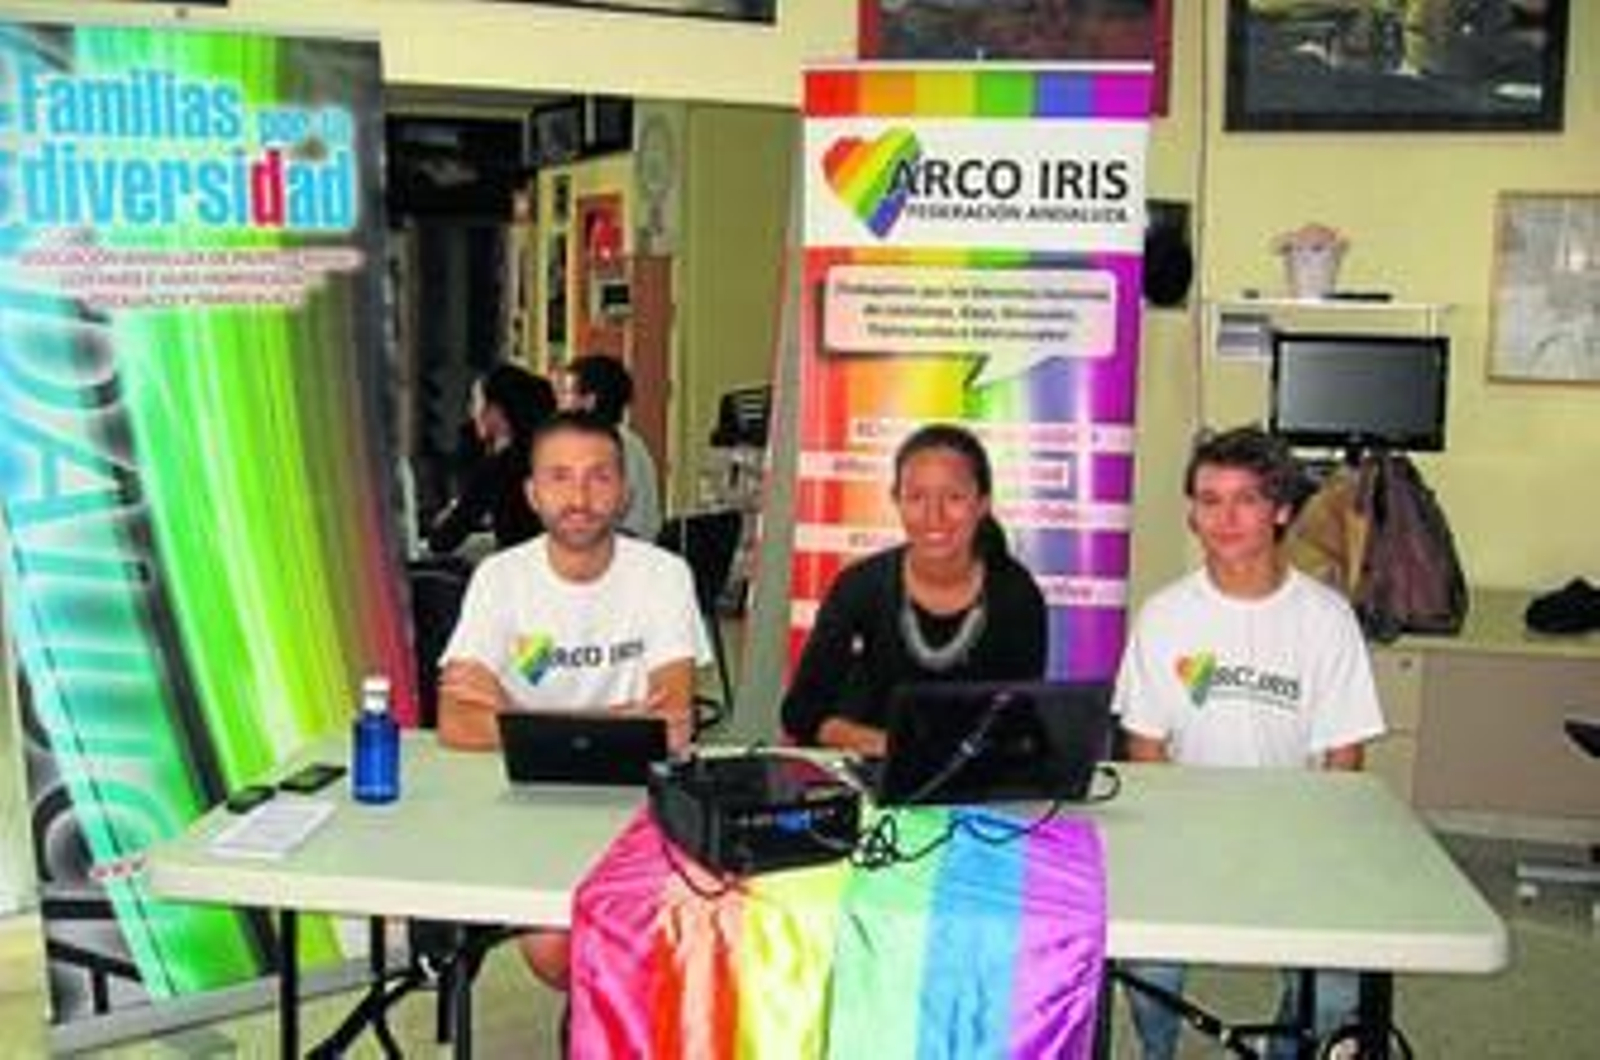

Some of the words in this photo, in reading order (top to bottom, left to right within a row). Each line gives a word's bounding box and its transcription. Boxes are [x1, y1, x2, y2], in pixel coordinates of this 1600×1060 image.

[19, 69, 241, 138] Familias
[20, 142, 353, 228] diversidad
[886, 159, 1022, 200] ARCO
[1039, 160, 1128, 201] IRIS
